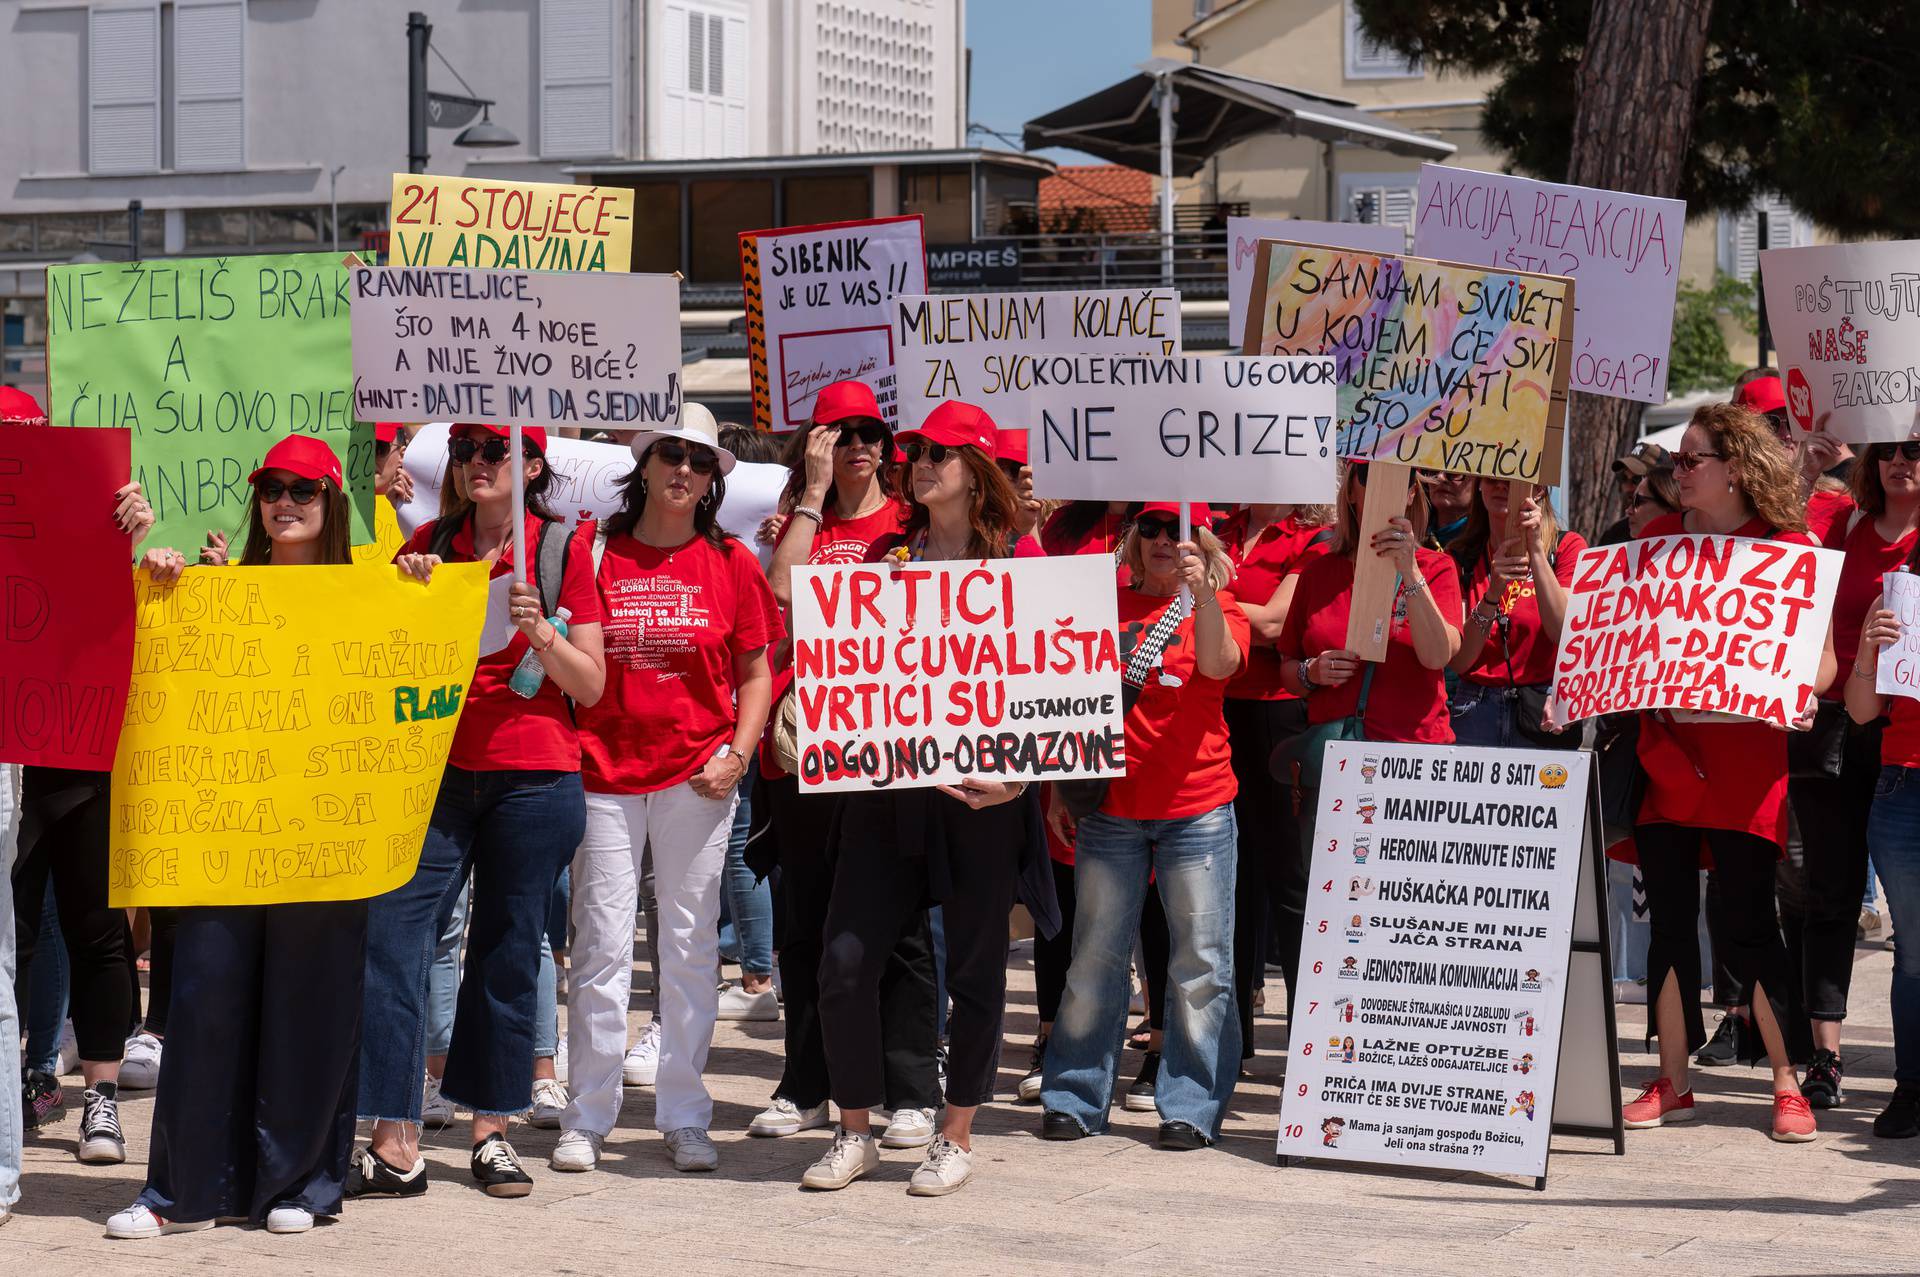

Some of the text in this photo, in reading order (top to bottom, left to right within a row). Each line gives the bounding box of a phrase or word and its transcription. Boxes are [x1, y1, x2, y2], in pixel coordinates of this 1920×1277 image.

[397, 185, 441, 225] 21.
[1421, 180, 1672, 276] AKCIJA, REAKCIJA,
[771, 237, 872, 277] ŠIBENIK
[52, 268, 106, 335] NE
[117, 258, 234, 323] ŽELIŠ
[357, 269, 543, 308] RAVNATELJICE,
[779, 284, 797, 310] JE
[806, 282, 831, 307] UZ
[1795, 274, 1920, 321] POŠTUJT
[395, 306, 598, 346] ŠTO IMA 4 NOGE
[900, 290, 1173, 346] MIJENJAM KOLAČE
[1276, 301, 1301, 339] U
[1452, 320, 1494, 366] ĆE
[1503, 336, 1559, 376] SVI
[1808, 316, 1869, 365] NAŠE
[164, 335, 190, 382] A
[395, 343, 638, 380] A NIJE ŽIVO BIĆE?
[1032, 357, 1337, 389] KOLEKTIVNI UGOVOR
[924, 359, 961, 398] ZA
[154, 391, 201, 433] SU
[215, 391, 276, 431] OVO
[290, 391, 372, 433] DJEC
[353, 376, 418, 417] (HINT:
[423, 382, 497, 417] DAJTE
[510, 386, 534, 418] IM
[550, 389, 578, 421] DA
[1353, 391, 1472, 437] ŠTO SU
[1042, 406, 1332, 464] NE GRIZE!
[1397, 433, 1543, 479] U VRTIĆU
[824, 543, 868, 559] HUNGRY
[1572, 536, 1735, 595] ZAKON
[1739, 542, 1817, 598] ZA
[612, 577, 649, 588] AKTIVIZAM
[620, 583, 650, 594] BORBA
[656, 584, 702, 594] SIGURNOST
[810, 559, 1014, 630] VRTIĆI
[655, 608, 668, 617] se
[1570, 580, 1815, 638] JEDNAKOST
[333, 628, 463, 680] VAŽNA
[797, 616, 1120, 680] NISU ČUVALIŠTA
[188, 688, 312, 735] NAMA
[798, 674, 1115, 733] VRTIĆI SU USTANOVE
[304, 725, 452, 778] STRAŠN
[800, 722, 1126, 788] ODGOJNO-OBRAZOVNE
[1338, 756, 1536, 786] 1 OVDJE SE RADI 8 SATI
[312, 793, 377, 826] DA
[1332, 797, 1559, 829] 2 MANIPULATORICA
[112, 847, 178, 889] SRCE
[202, 851, 229, 884] U
[1327, 837, 1557, 870] 3 HEROINA IZVRNUTE ISTINE
[1322, 880, 1333, 893] 4
[1378, 877, 1469, 906] HUŠKAČKA
[1474, 886, 1550, 911] POLITIKA
[1318, 916, 1548, 938] 5 SLUŠANJE MI NIJE
[1389, 932, 1522, 952] JAČA STRANA
[1313, 958, 1518, 992] 6 JEDNOSTRANA KOMUNIKACIJA
[1308, 997, 1511, 1021] 7 DOVOĐENJE ŠTRAJKAŠICA U ZABLUDU
[1361, 1013, 1507, 1034] OBMANJIVANJE JAVNOSTI
[1302, 1038, 1509, 1060] 8 LAŽNE OPTUŽBE
[1358, 1051, 1508, 1074] BOŽICE, LAŽEŠ ODGAJATELJICE
[1298, 1075, 1508, 1104] 9 PRIČA IMA DVIJE STRANE,
[1321, 1090, 1506, 1116] OTKRIT ĆE SE SVE TVOJE MANE
[1284, 1119, 1524, 1147] 10 Mama ja sanjam gospođu Božicu,
[1384, 1137, 1485, 1156] Jeli ona strašna ??
